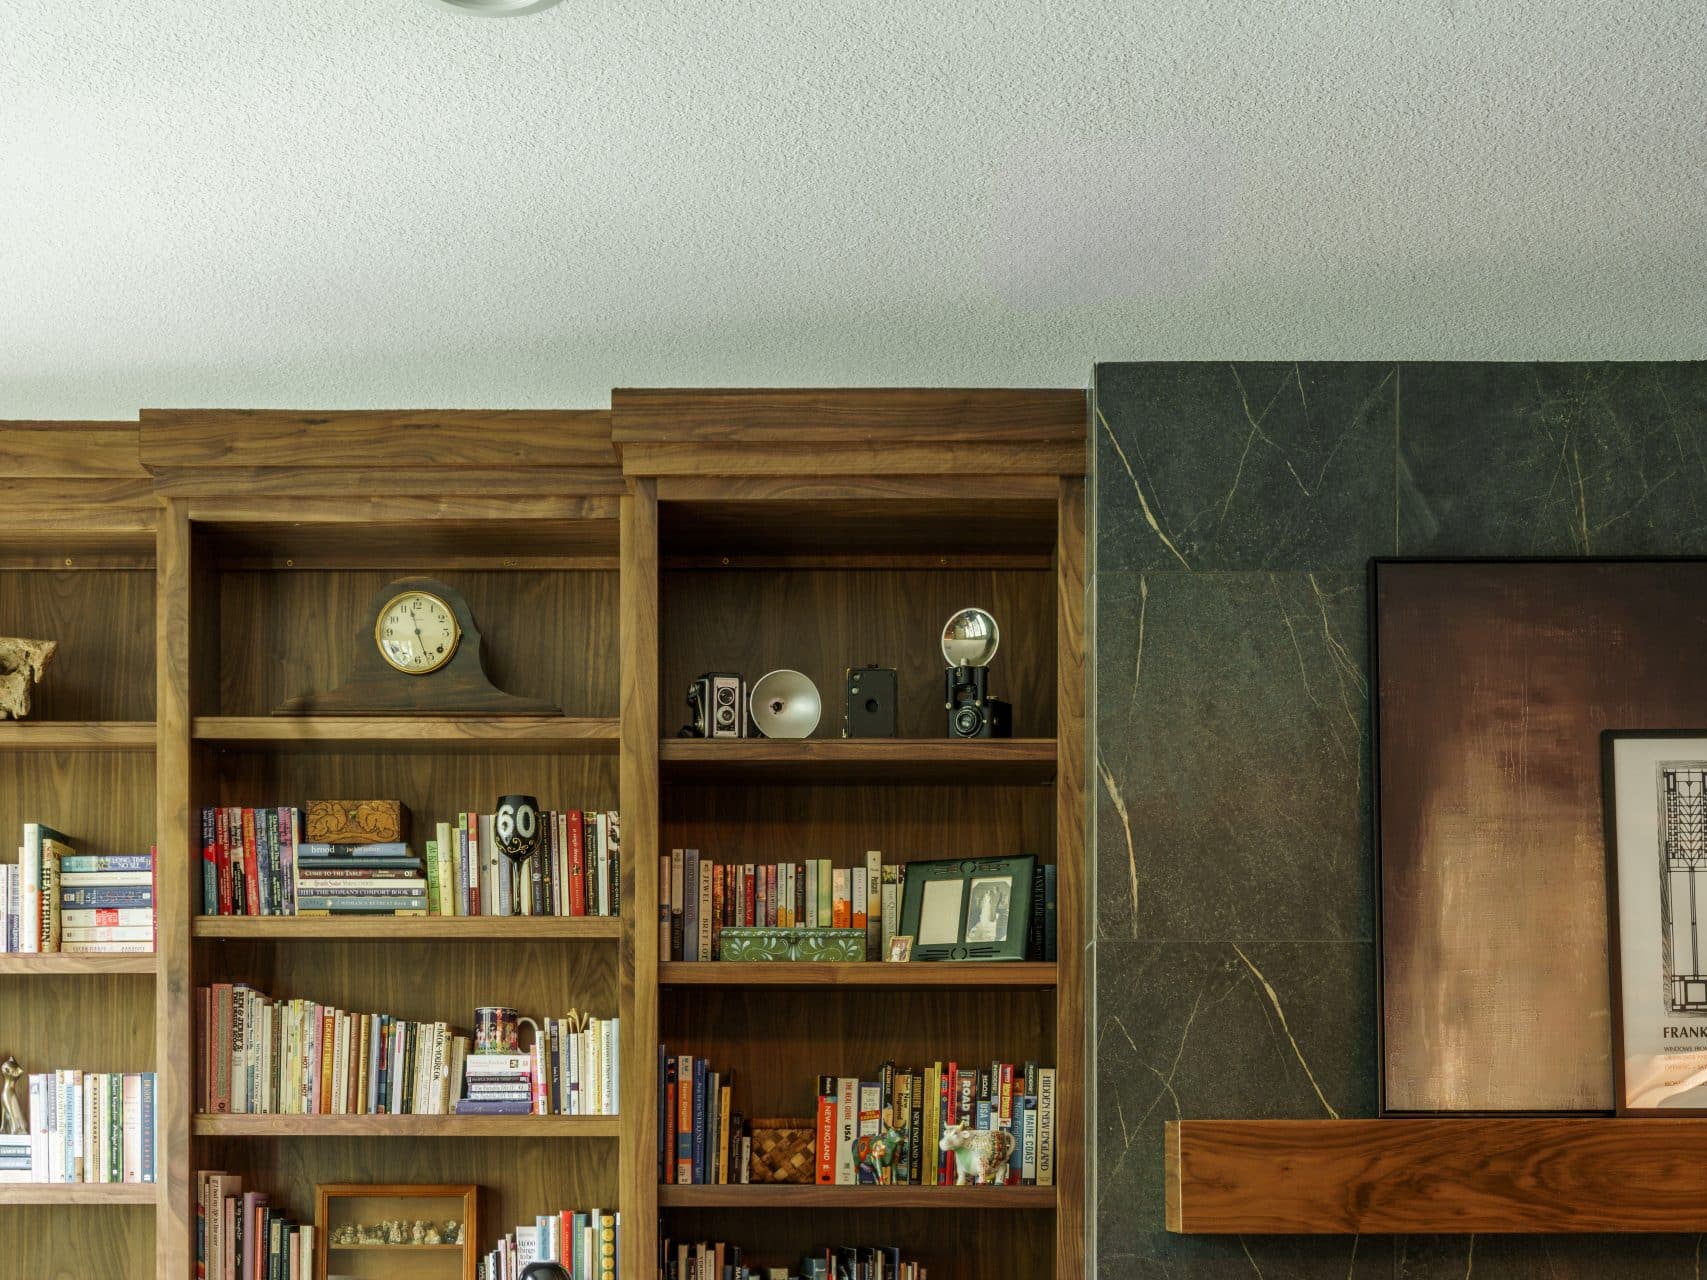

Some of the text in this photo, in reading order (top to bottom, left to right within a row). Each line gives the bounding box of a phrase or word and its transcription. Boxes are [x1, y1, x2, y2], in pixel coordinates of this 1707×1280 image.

[497, 804, 536, 842] 60
[311, 845, 335, 854] brood
[41, 867, 51, 943] HEARTBURN
[325, 1018, 333, 1052] ECKHART
[1663, 1026, 1707, 1038] FRANK
[844, 1081, 853, 1142] THE REAL GUIDE USA
[903, 1093, 911, 1109] New
[962, 1080, 971, 1112] ROAD
[980, 1103, 989, 1119] USA
[823, 1105, 832, 1161] NEW ENGLAND
[912, 1111, 920, 1159] NEW ENGLAND
[1025, 1114, 1034, 1165] MAINE COAST
[1040, 1076, 1051, 1171] HIDDEN NEW ENGLAND
